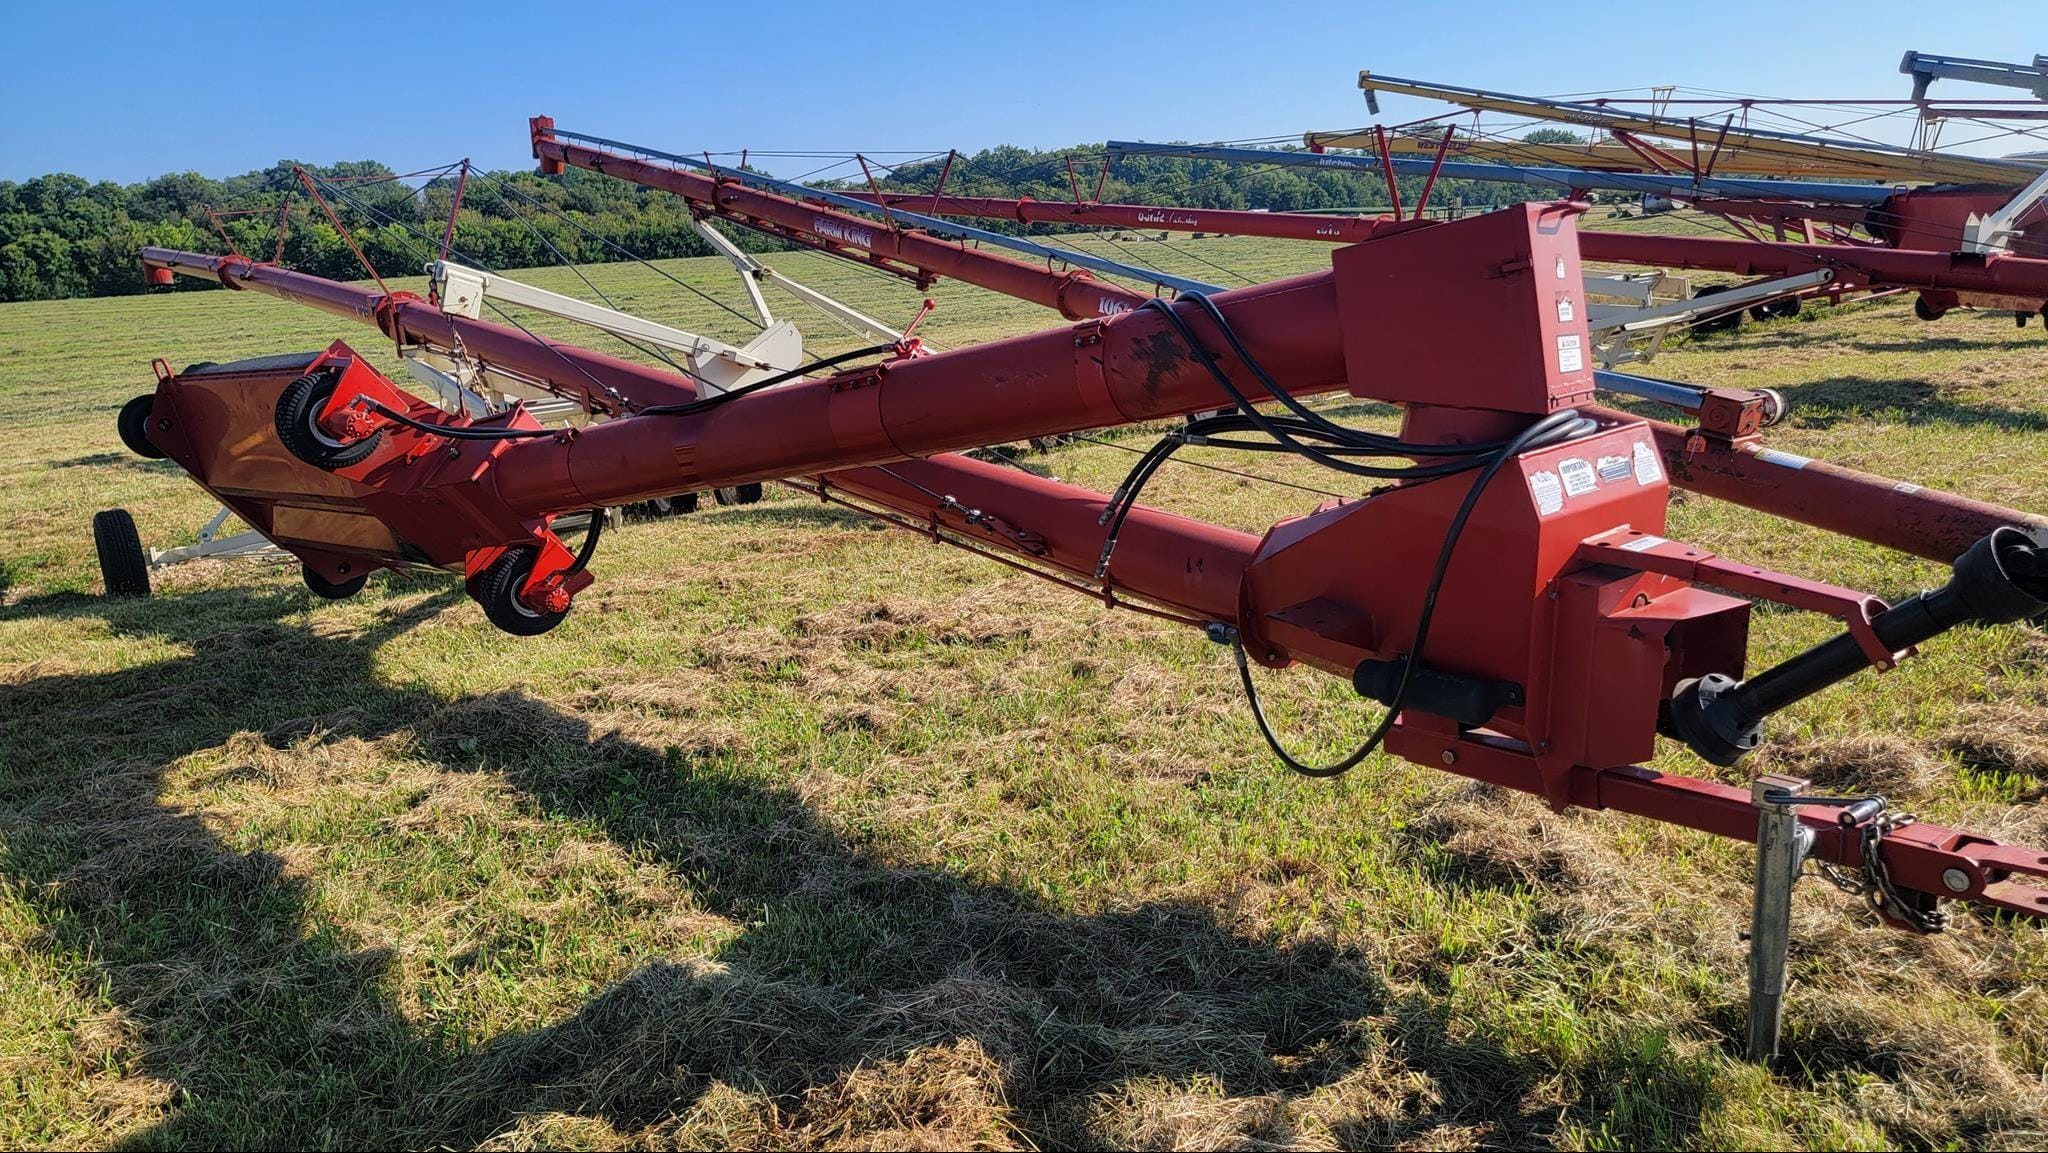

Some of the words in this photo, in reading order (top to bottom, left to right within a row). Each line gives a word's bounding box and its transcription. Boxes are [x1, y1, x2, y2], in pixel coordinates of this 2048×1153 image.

[1416, 140, 1468, 150] WESTELD
[814, 217, 843, 240] FARM
[843, 224, 873, 248] KING
